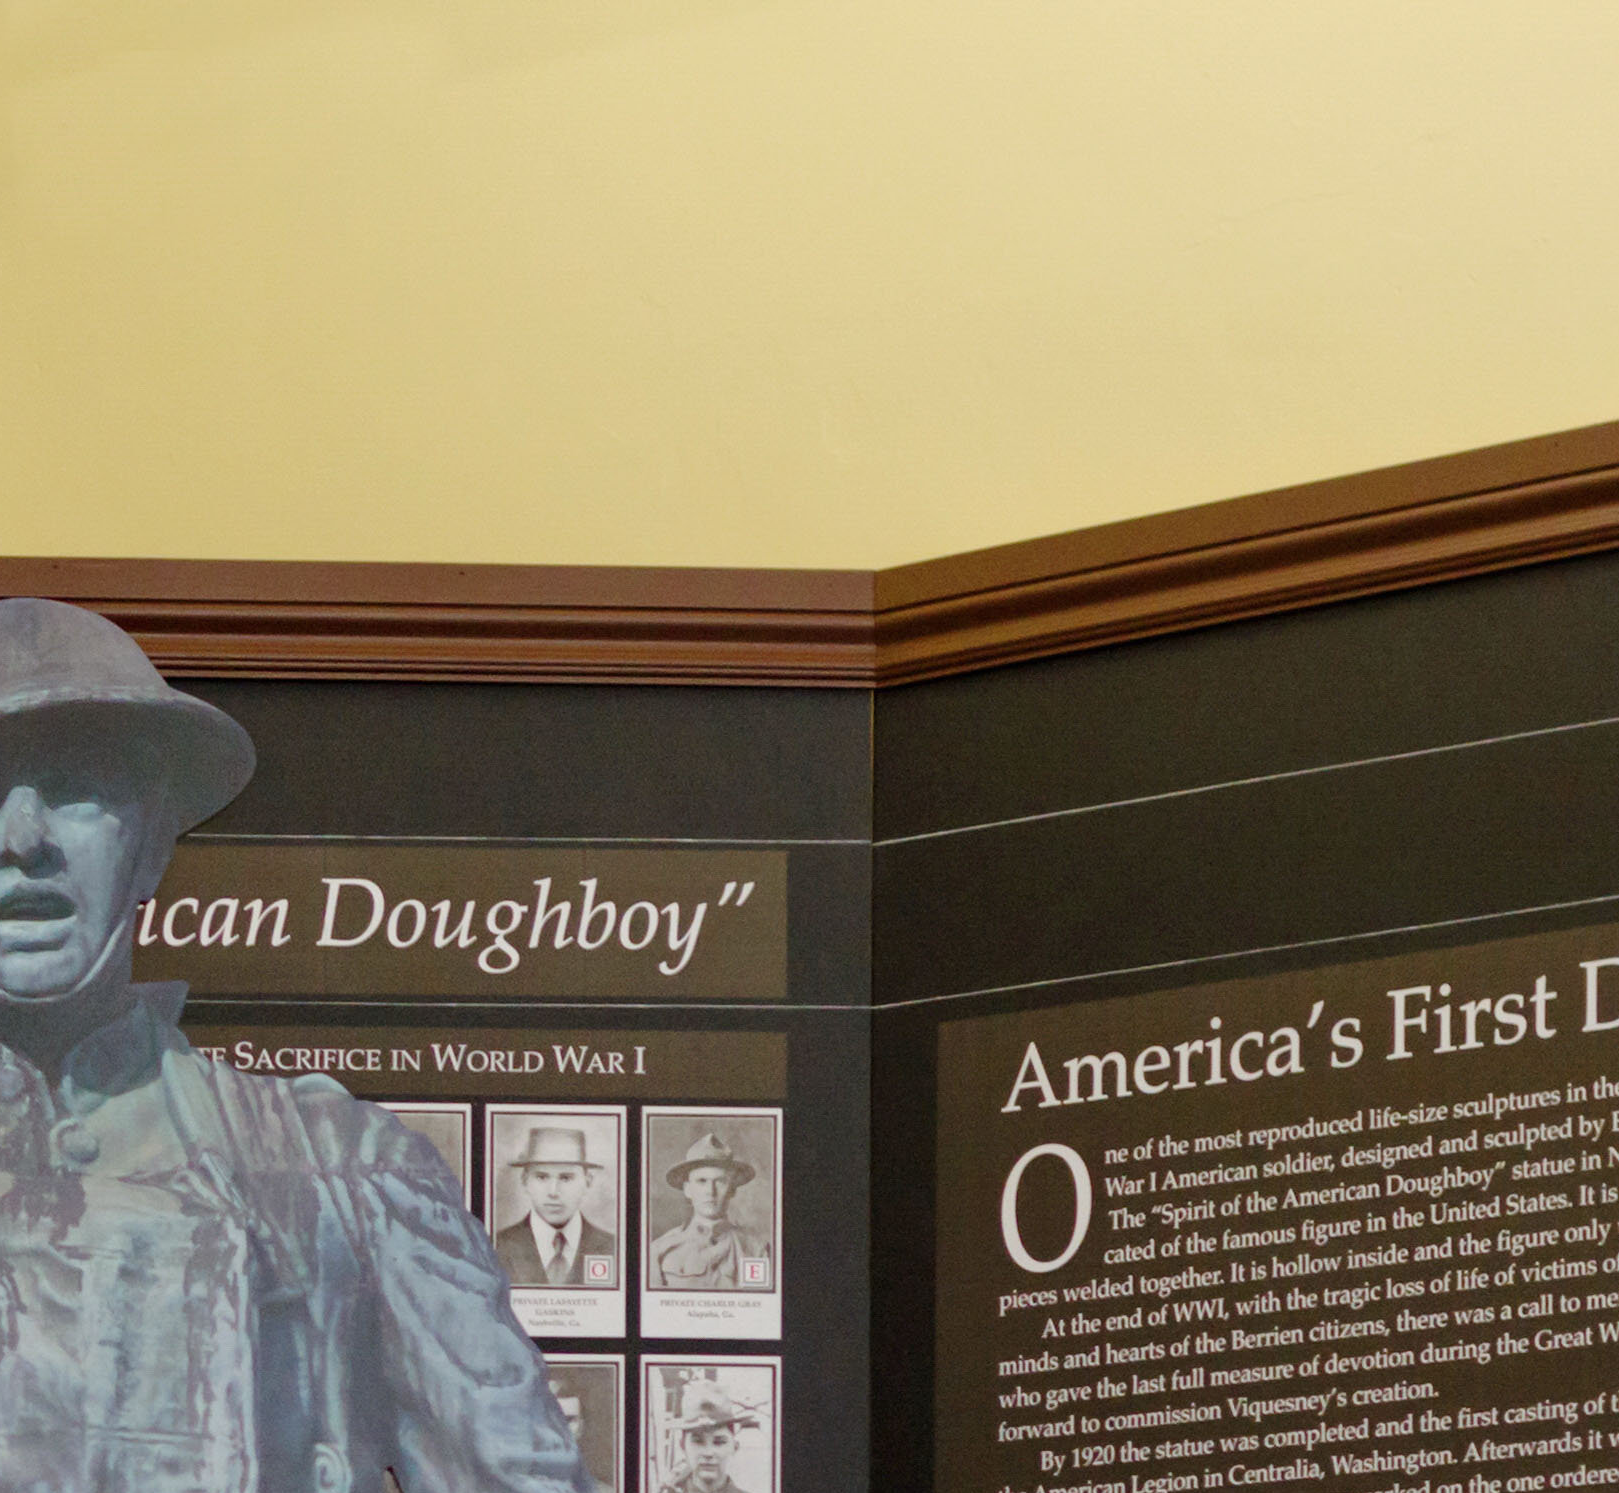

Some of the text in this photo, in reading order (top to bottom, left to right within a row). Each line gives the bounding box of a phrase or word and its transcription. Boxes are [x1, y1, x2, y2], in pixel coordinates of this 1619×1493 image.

[315, 876, 756, 976] Doughboy"
[1001, 998, 1364, 1114] America's
[1385, 973, 1558, 1061] First
[1103, 1174, 1146, 1198] War
[1148, 1170, 1157, 1193] I
[1159, 1161, 1259, 1191] American
[1261, 1150, 1336, 1179] soldier,
[1339, 1133, 1434, 1168] designed
[1437, 1128, 1479, 1156] and
[1482, 1115, 1574, 1150] sculpted
[1577, 1113, 1606, 1140] by
[1131, 1136, 1154, 1162] of
[1156, 1133, 1190, 1158] the
[1192, 1127, 1244, 1154] most
[1246, 1108, 1364, 1148] reproduced
[1367, 1101, 1449, 1131] life-size
[1451, 1088, 1562, 1120] sculptures
[1564, 1080, 1588, 1104] in
